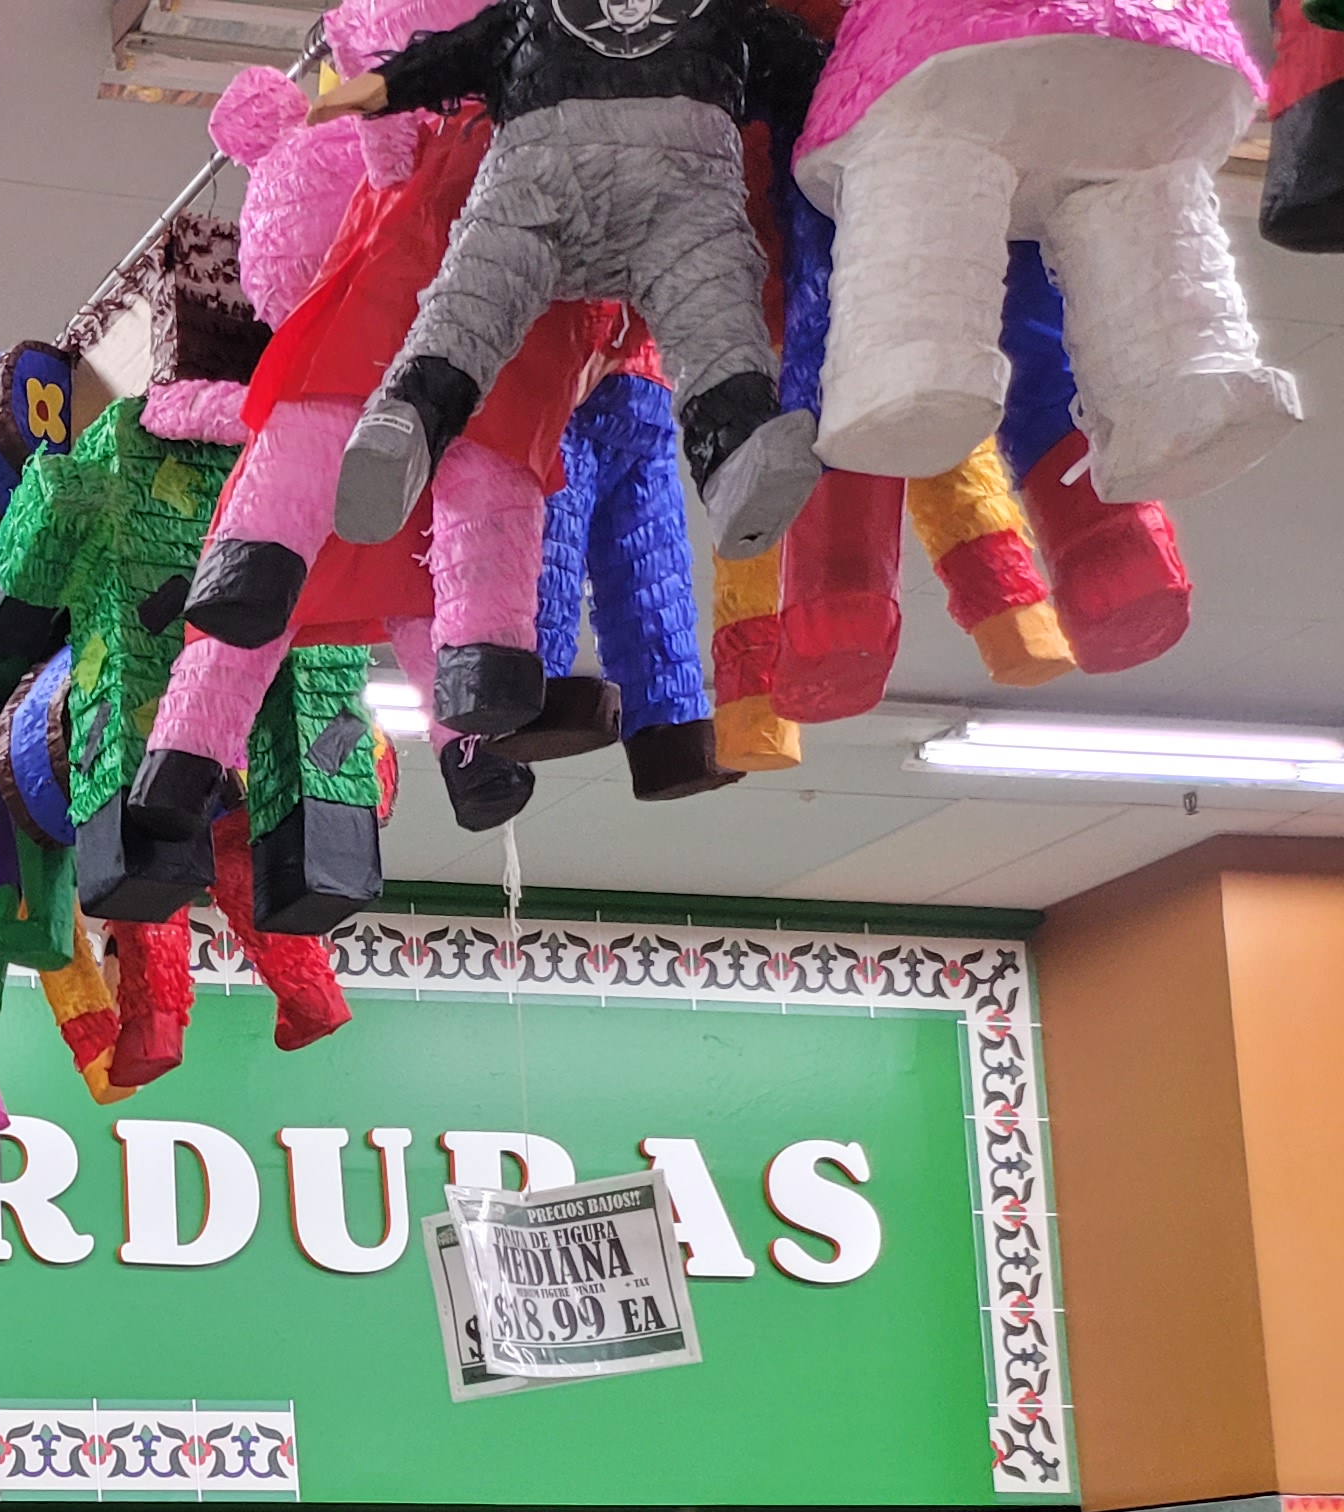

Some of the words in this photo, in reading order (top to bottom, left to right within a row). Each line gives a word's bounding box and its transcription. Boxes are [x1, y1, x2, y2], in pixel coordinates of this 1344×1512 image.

[527, 1201, 585, 1224] PRECIOS
[588, 1190, 642, 1214] BAJOS!!
[531, 1231, 550, 1249] DE
[552, 1220, 619, 1245] FIGURA
[493, 1238, 634, 1287] MEDIANA
[541, 1286, 571, 1299] FIGURE
[633, 1276, 651, 1289] TAX
[493, 1293, 606, 1343] $18.99
[618, 1295, 667, 1335] EA
